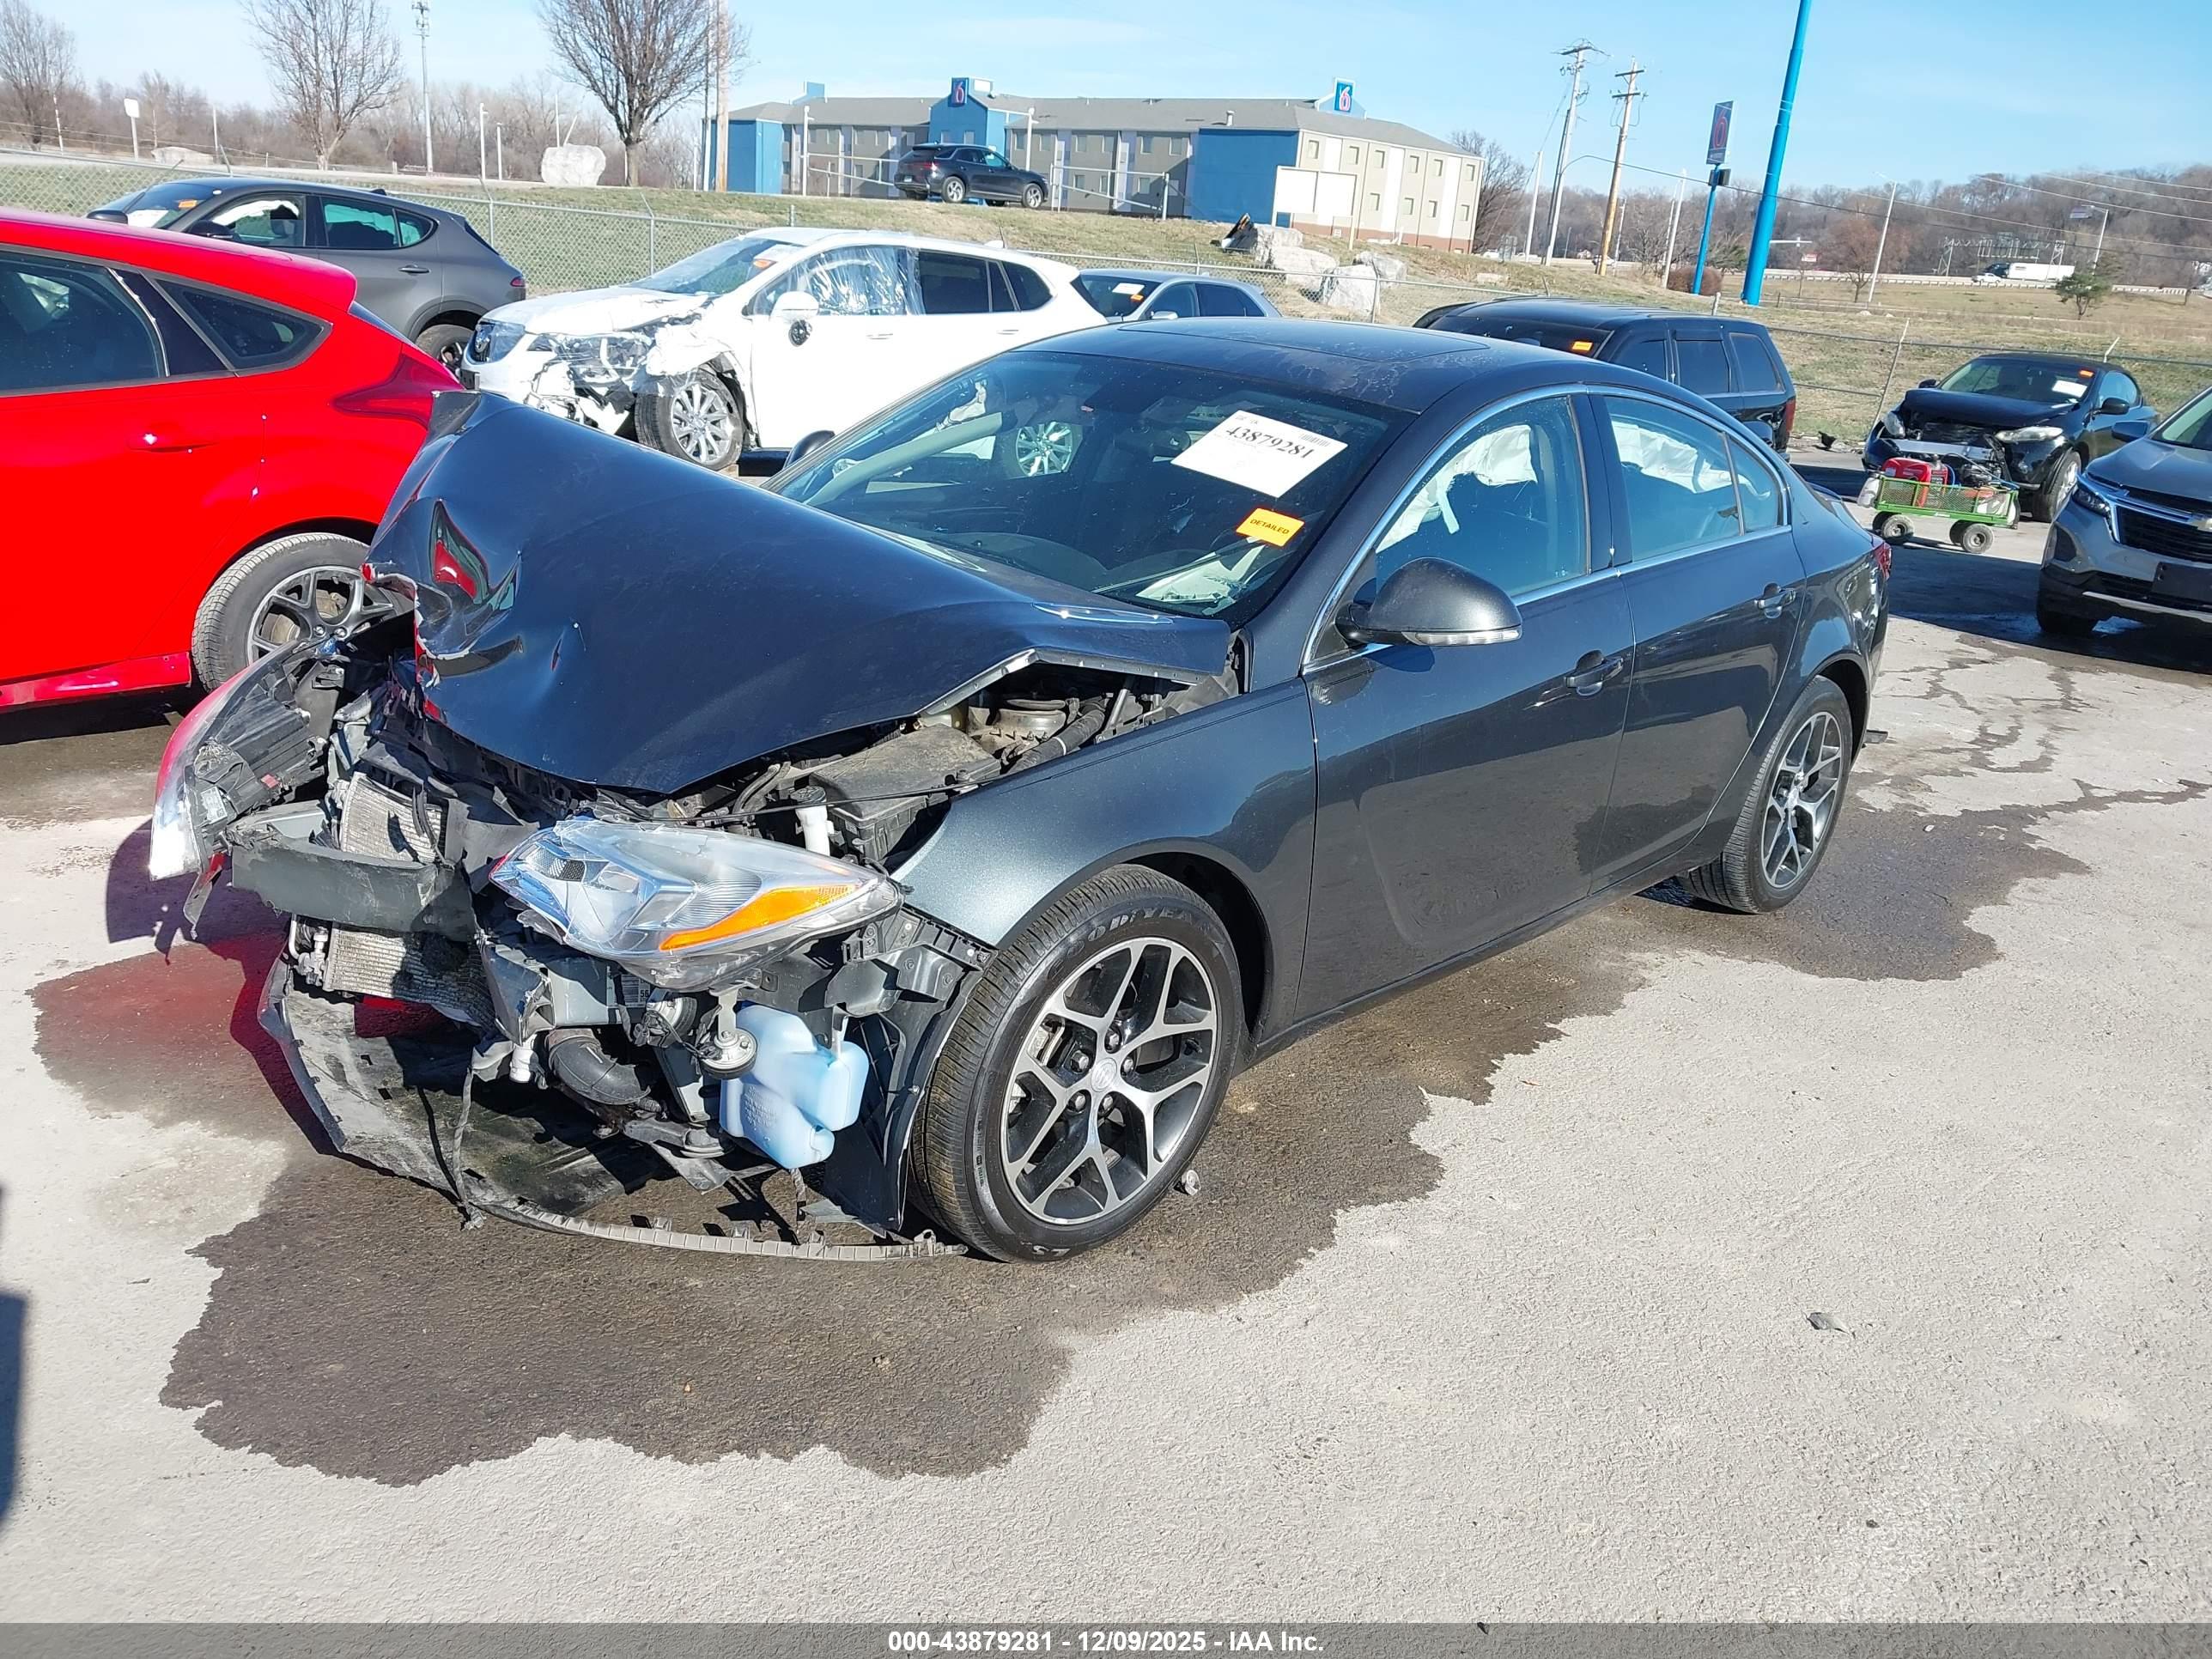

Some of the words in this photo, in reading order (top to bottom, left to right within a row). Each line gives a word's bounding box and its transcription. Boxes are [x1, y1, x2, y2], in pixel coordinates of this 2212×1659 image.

[956, 81, 964, 104] 6
[1339, 86, 1351, 111] 6
[1713, 109, 1728, 149] 6
[1225, 426, 1316, 459] 43879281
[1249, 519, 1290, 534] DETAILED
